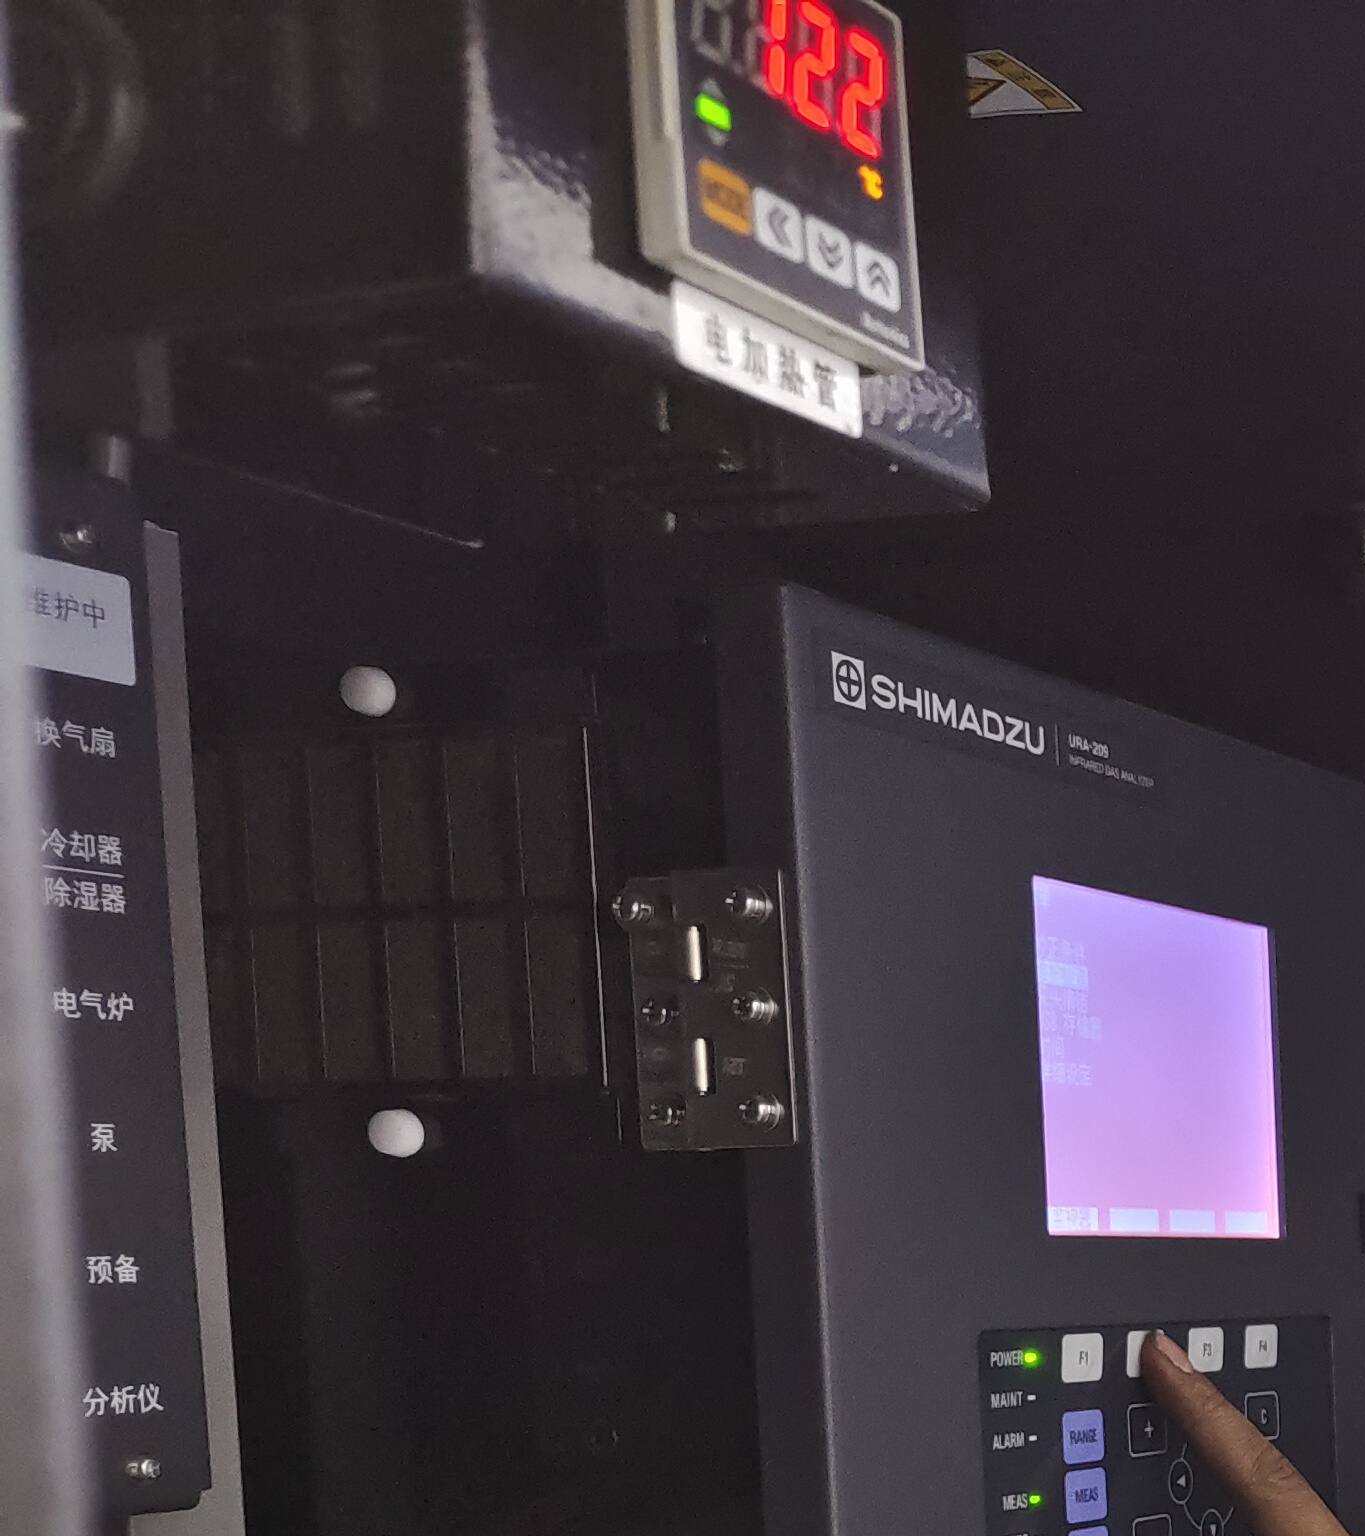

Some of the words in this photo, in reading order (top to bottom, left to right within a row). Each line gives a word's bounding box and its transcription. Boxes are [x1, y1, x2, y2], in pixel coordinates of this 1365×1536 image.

[871, 674, 1045, 755] SHIMADZU
[41, 826, 123, 867] 冷却器
[44, 876, 127, 914] 除湿器
[53, 988, 135, 1021] 电气炉
[91, 1122, 117, 1153] 泵
[85, 1254, 140, 1285] 预备
[990, 1350, 1024, 1367] POWER
[1078, 1351, 1089, 1366] F1
[1203, 1342, 1213, 1357] F3
[82, 1383, 164, 1418] 分析仪
[990, 1391, 1024, 1409] MAINT
[992, 1432, 1025, 1451] ALARM
[1069, 1428, 1097, 1446] RANGE
[1002, 1493, 1029, 1512] MEAS
[1074, 1486, 1099, 1503] MEAS
